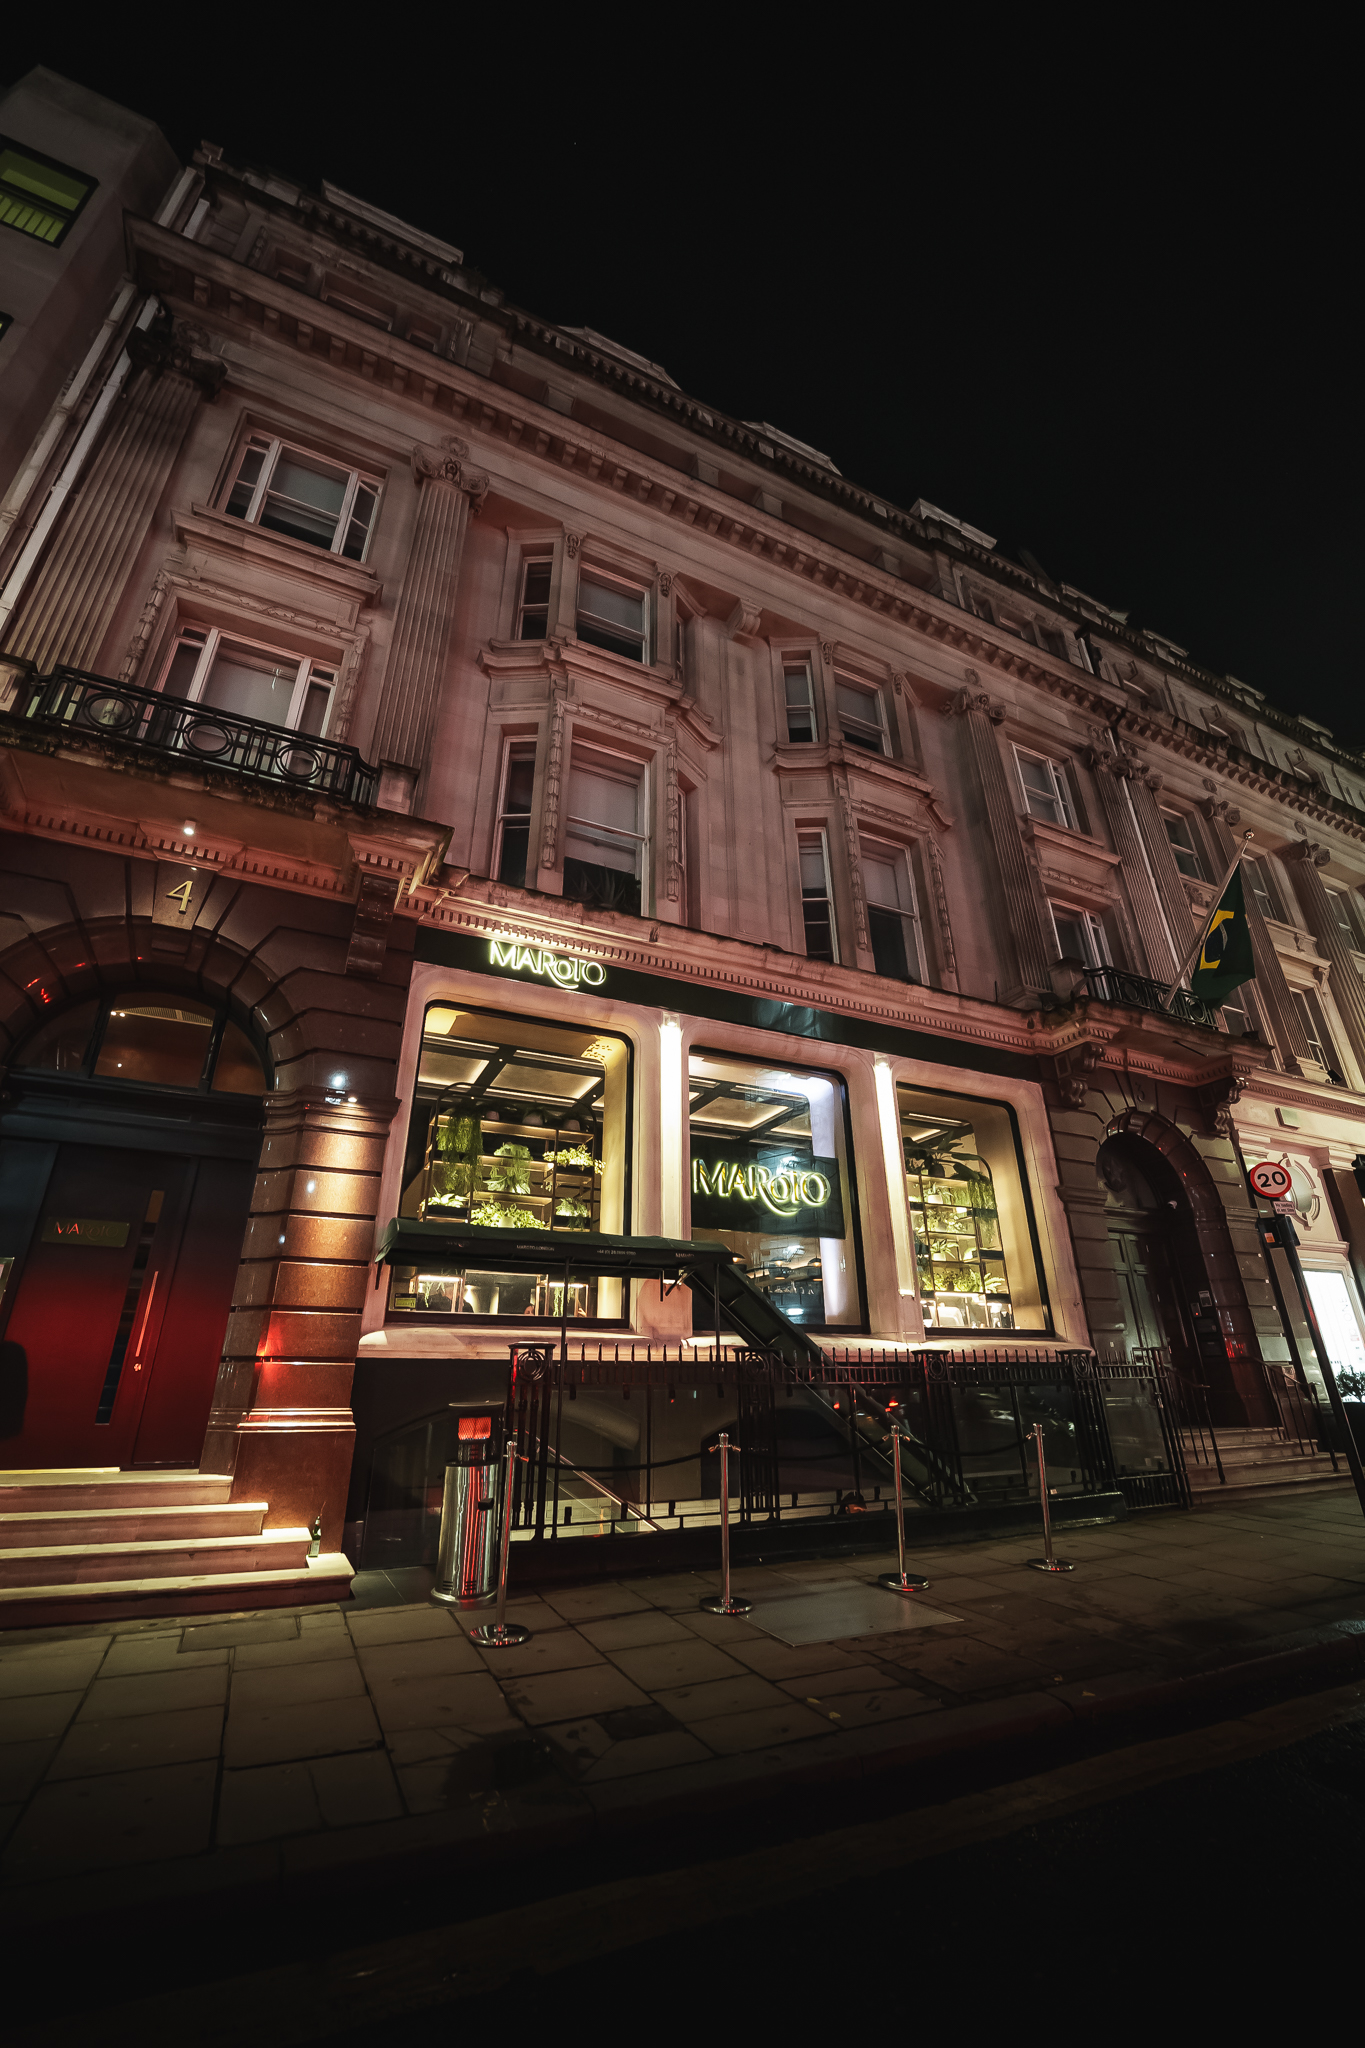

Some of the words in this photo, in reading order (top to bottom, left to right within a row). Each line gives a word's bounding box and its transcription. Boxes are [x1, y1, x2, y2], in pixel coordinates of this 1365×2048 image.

[165, 880, 194, 914] 4
[489, 939, 607, 989] MAROTO
[692, 1158, 832, 1217] MAROTO
[1257, 1171, 1286, 1188] 20
